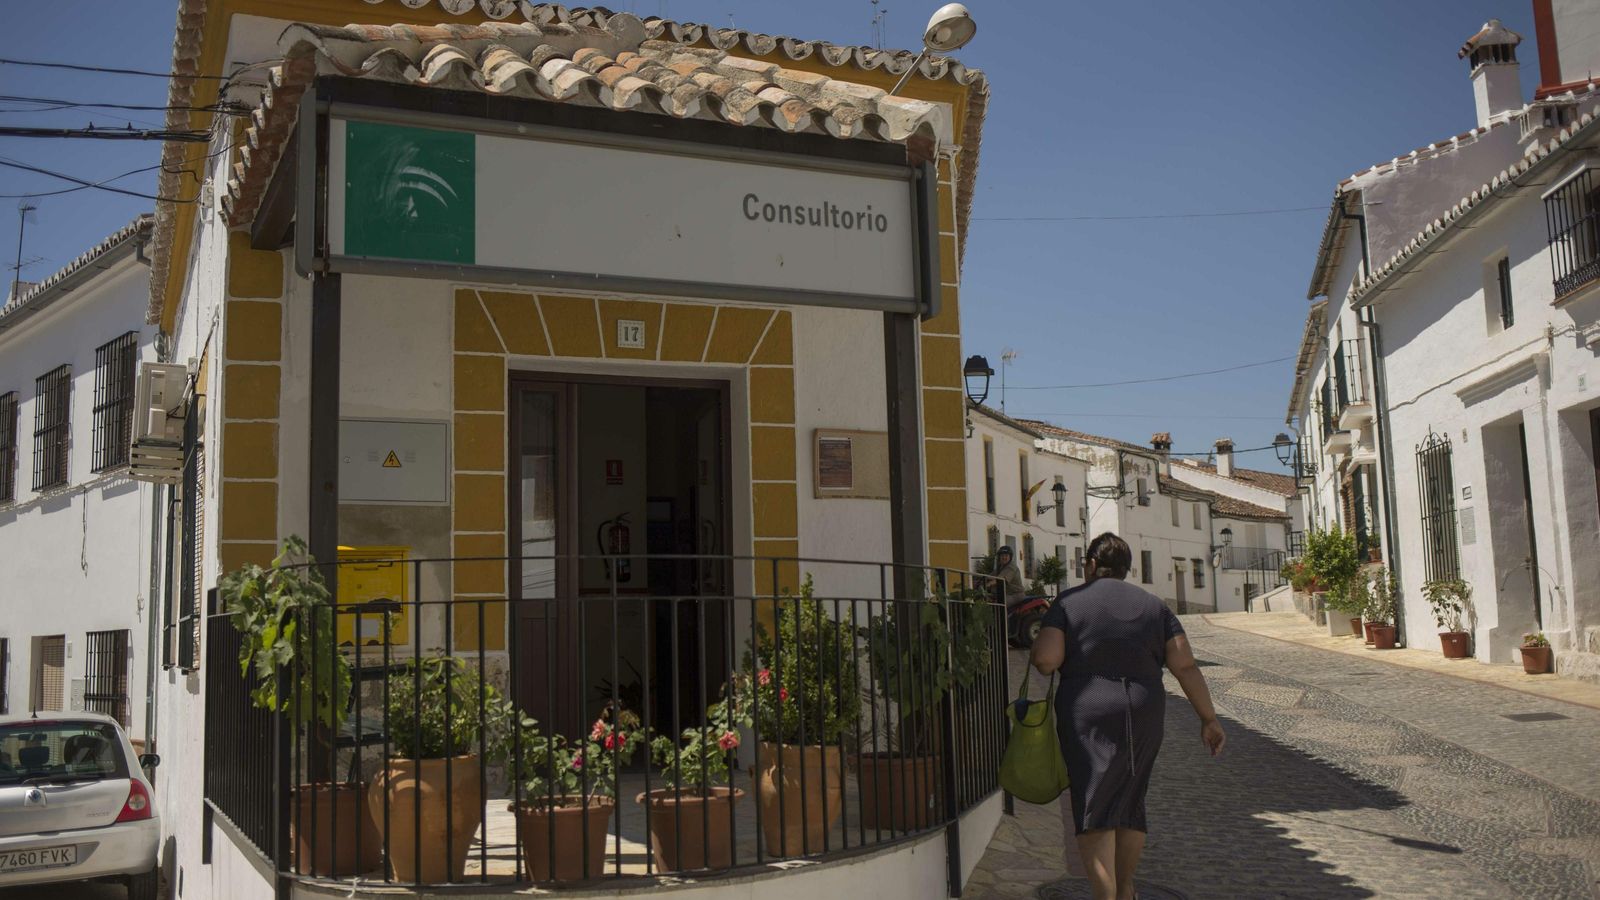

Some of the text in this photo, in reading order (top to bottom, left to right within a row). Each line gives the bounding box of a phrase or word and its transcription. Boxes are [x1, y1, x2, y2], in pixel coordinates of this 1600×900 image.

[742, 193, 888, 233] Consultorio
[623, 326, 639, 342] 17
[0, 848, 70, 868] 7460 FVK
